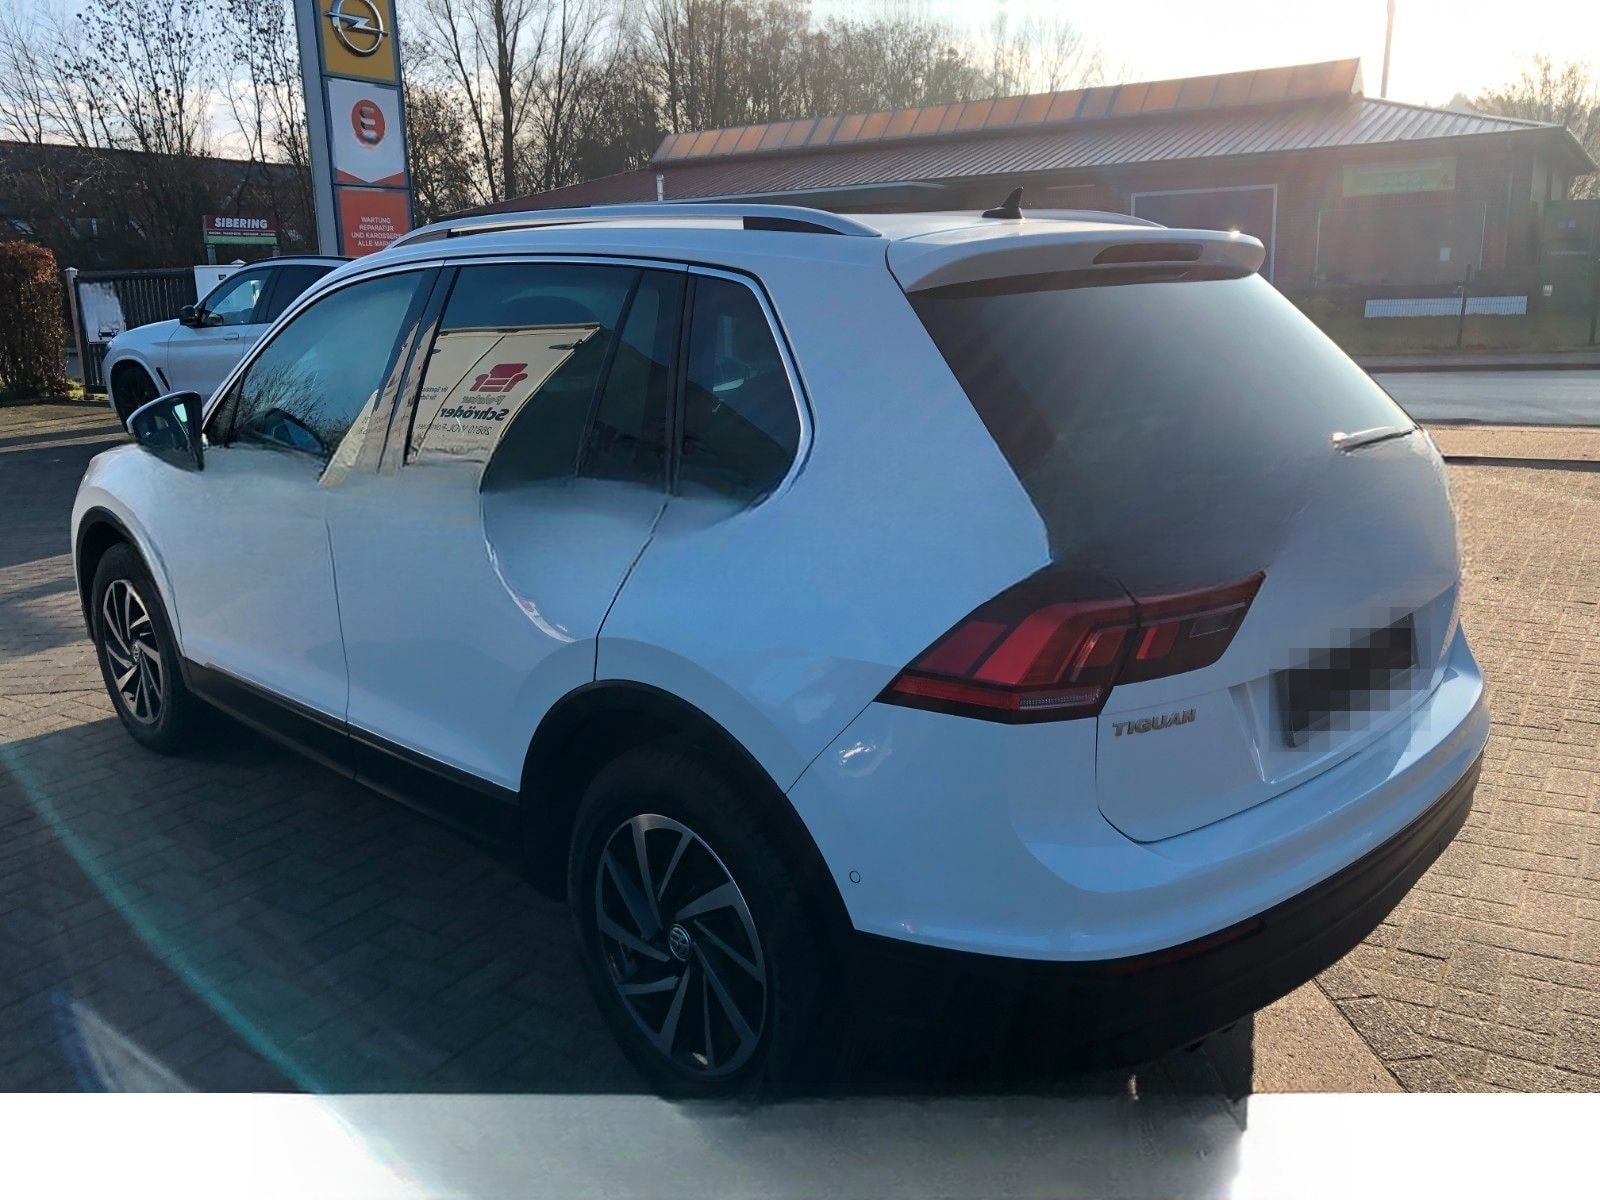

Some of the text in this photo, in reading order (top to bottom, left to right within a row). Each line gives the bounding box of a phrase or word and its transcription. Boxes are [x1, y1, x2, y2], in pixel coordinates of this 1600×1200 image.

[214, 217, 268, 229] SIBERING
[360, 216, 391, 224] WARTUNG
[358, 224, 395, 232] REPARATUR
[1112, 708, 1196, 737] TIGUAN
